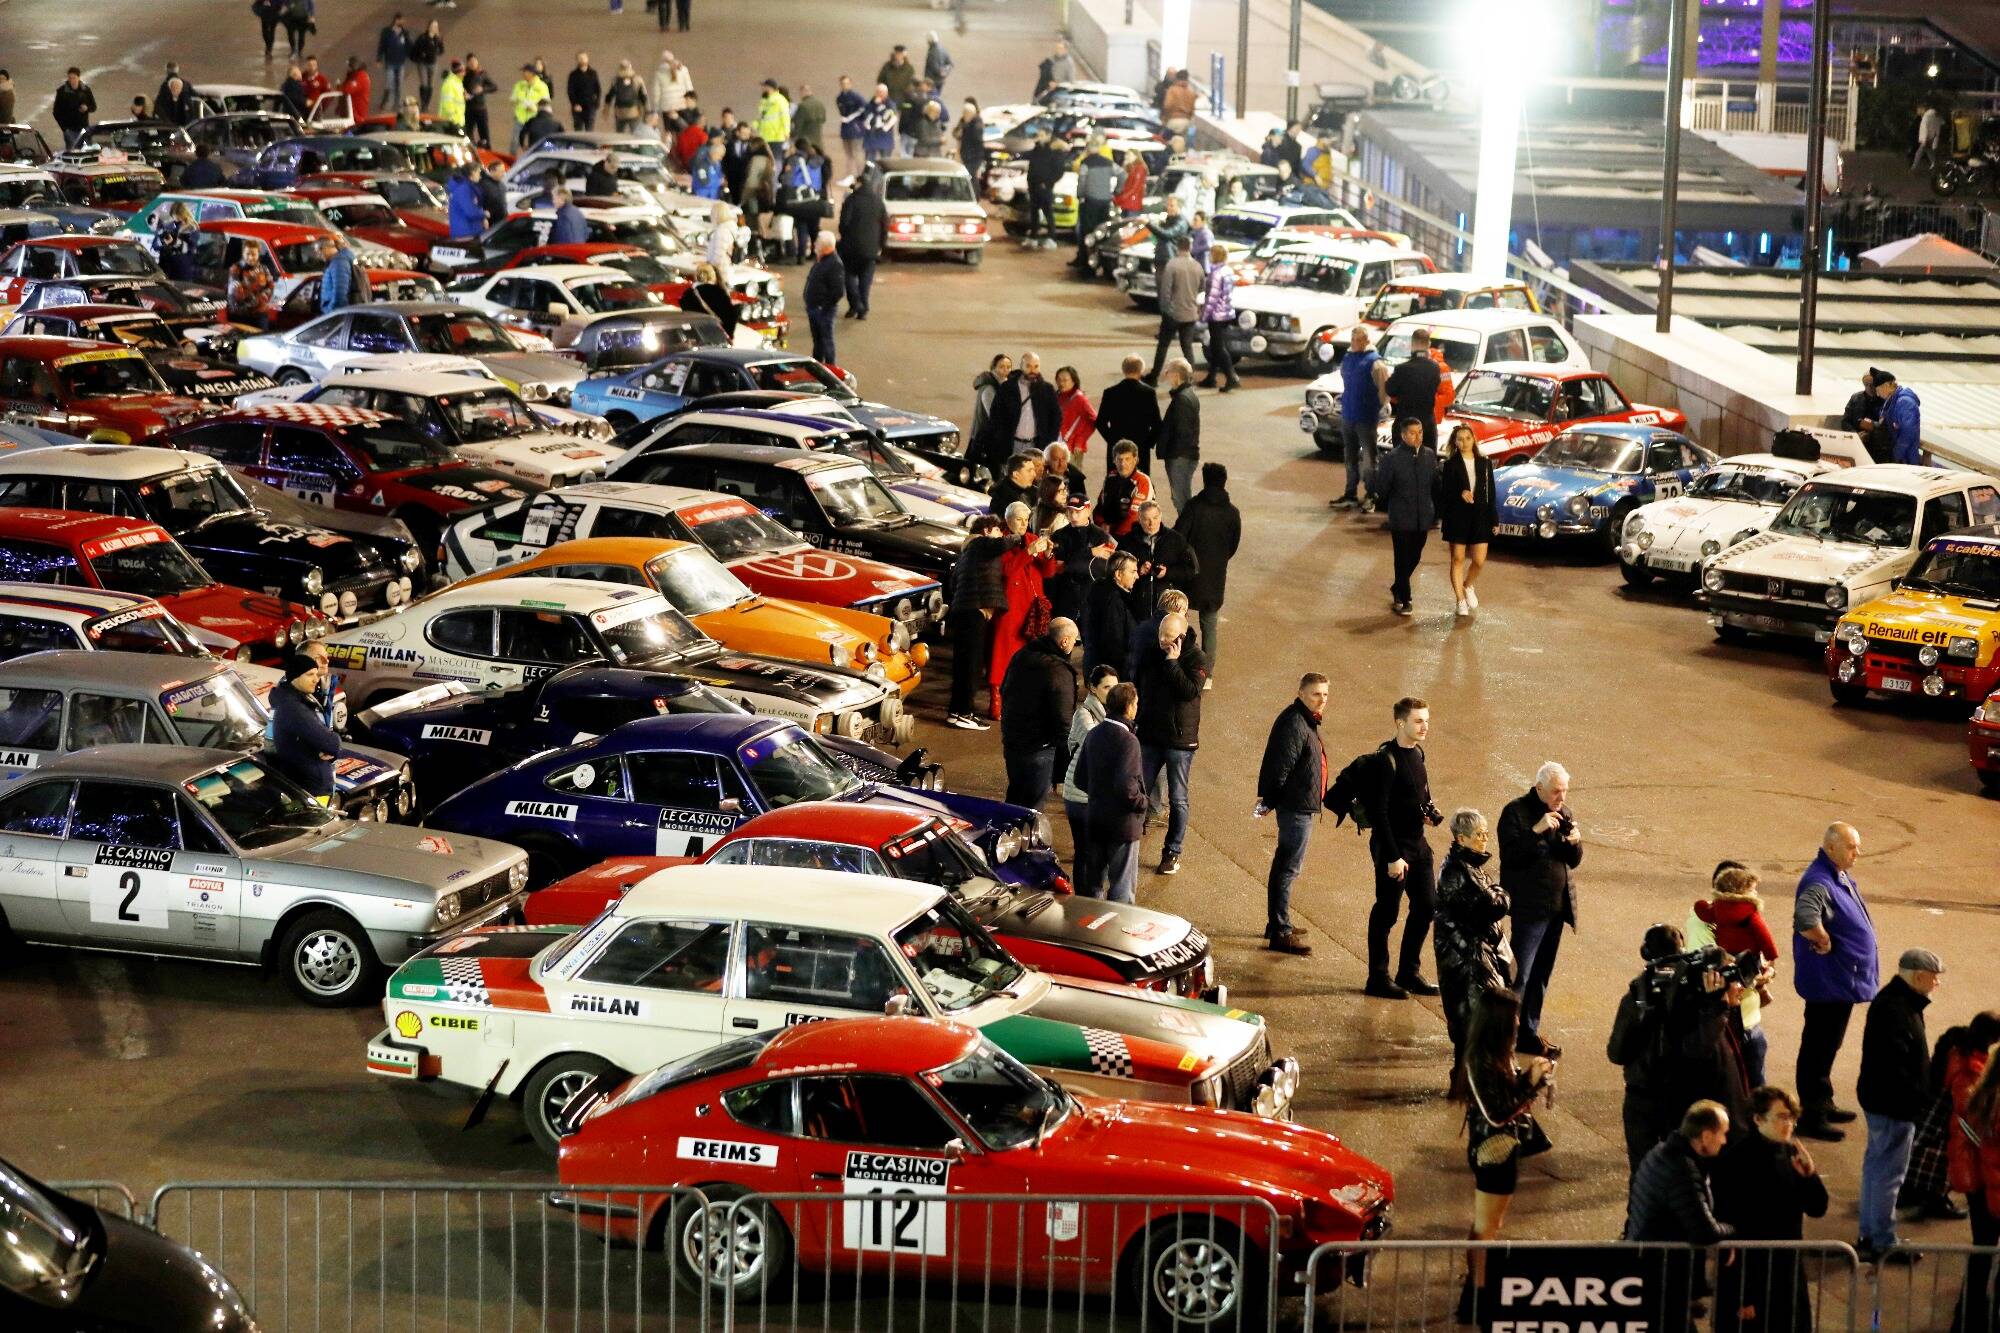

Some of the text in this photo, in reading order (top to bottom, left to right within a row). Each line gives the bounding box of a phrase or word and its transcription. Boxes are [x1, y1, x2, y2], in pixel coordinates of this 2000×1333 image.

[611, 387, 640, 399] MILAN
[1867, 622, 1948, 645] Renault elf
[370, 646, 416, 662] MILAN
[428, 655, 482, 670] MASCOTTE
[1889, 679, 1910, 690] 3137
[777, 709, 809, 720] CANCER
[429, 726, 483, 743] MILAN
[513, 802, 569, 818] MILAN
[662, 810, 732, 827] LE CASINO
[99, 845, 172, 863] LE CASINO
[190, 880, 222, 890] MOTUL
[118, 870, 142, 922] 2
[186, 901, 223, 910] TRIANON
[571, 994, 641, 1017] MILAN
[430, 1016, 479, 1030] CIBIE
[692, 1140, 762, 1163] REIMS
[850, 1153, 945, 1176] LE CASINO
[868, 1187, 920, 1248] 12
[1500, 1276, 1644, 1307] PARC
